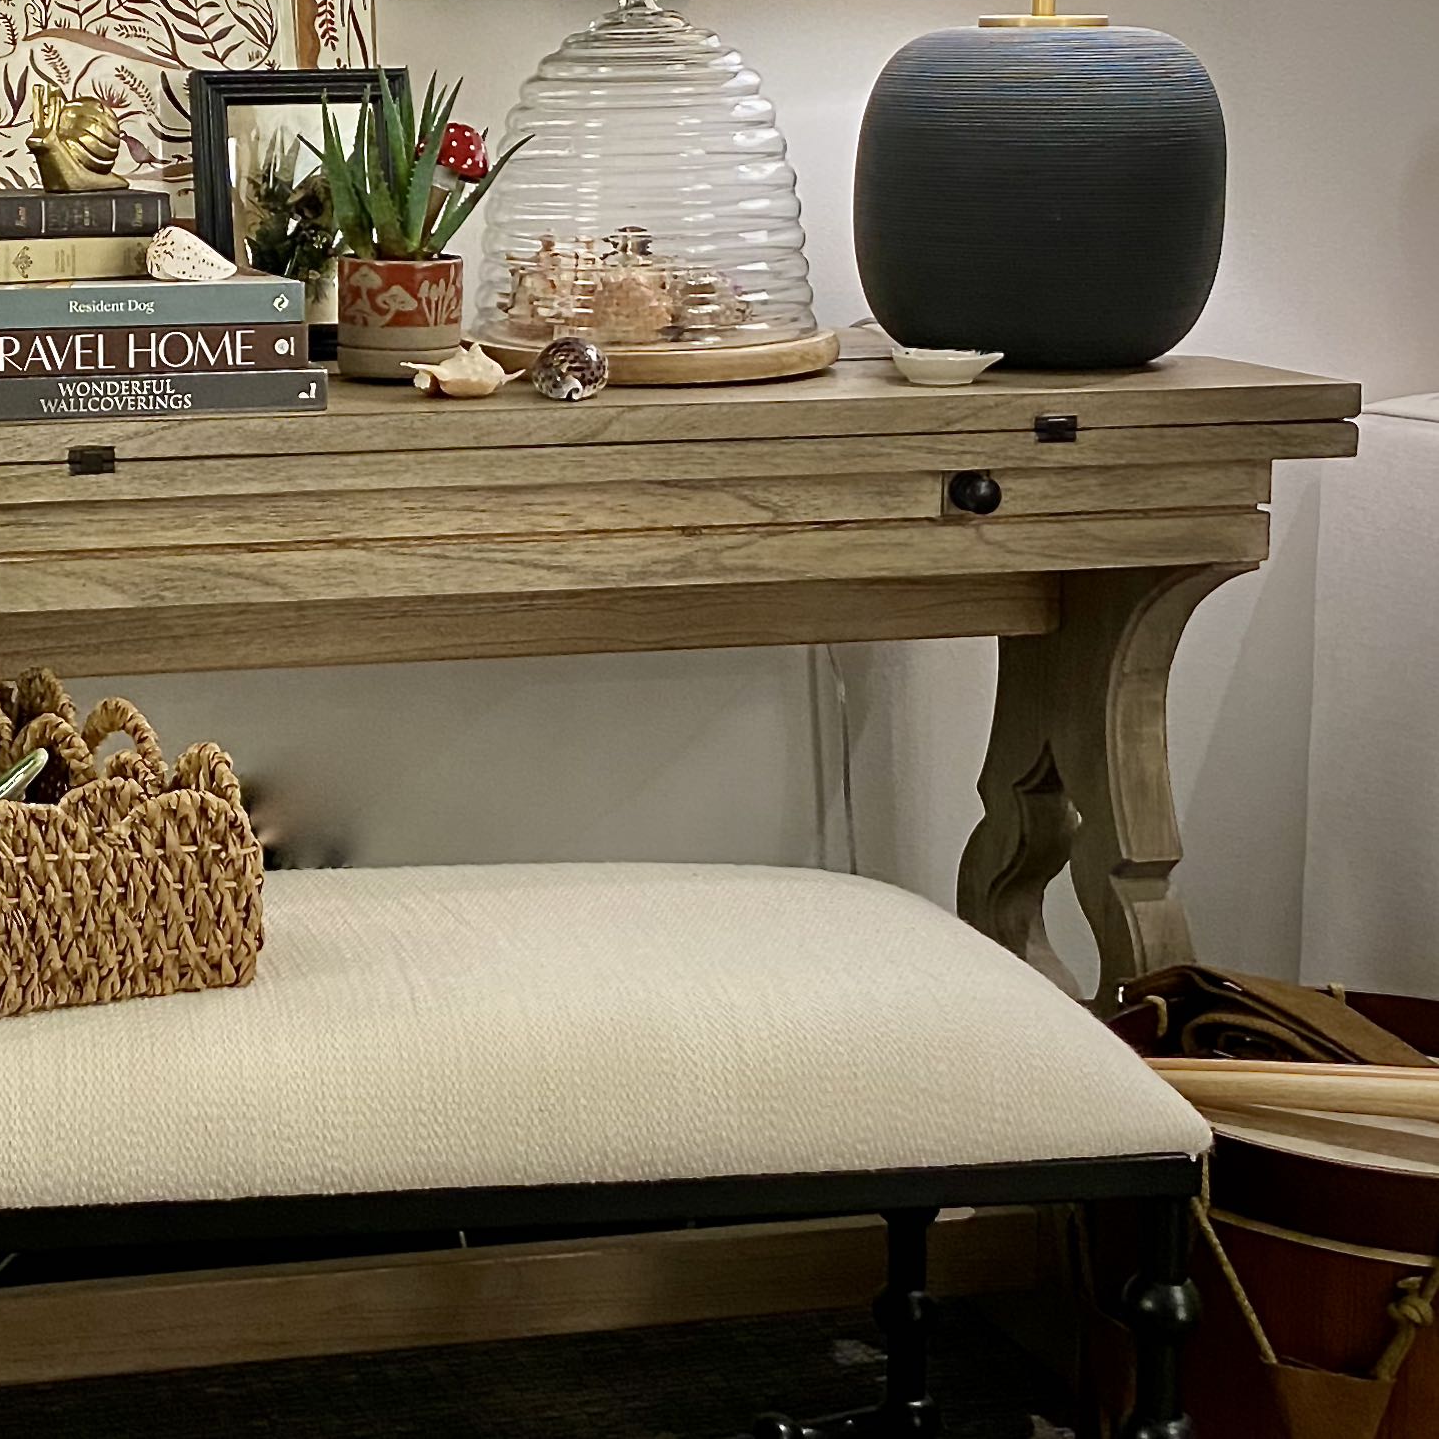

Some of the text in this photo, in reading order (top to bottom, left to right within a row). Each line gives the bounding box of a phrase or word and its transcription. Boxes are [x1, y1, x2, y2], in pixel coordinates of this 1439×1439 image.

[68, 299, 155, 315] Resident Dog
[128, 329, 256, 368] HOME
[58, 378, 176, 397] WONDERFUL
[39, 393, 192, 413] WALLCOVERINGS
